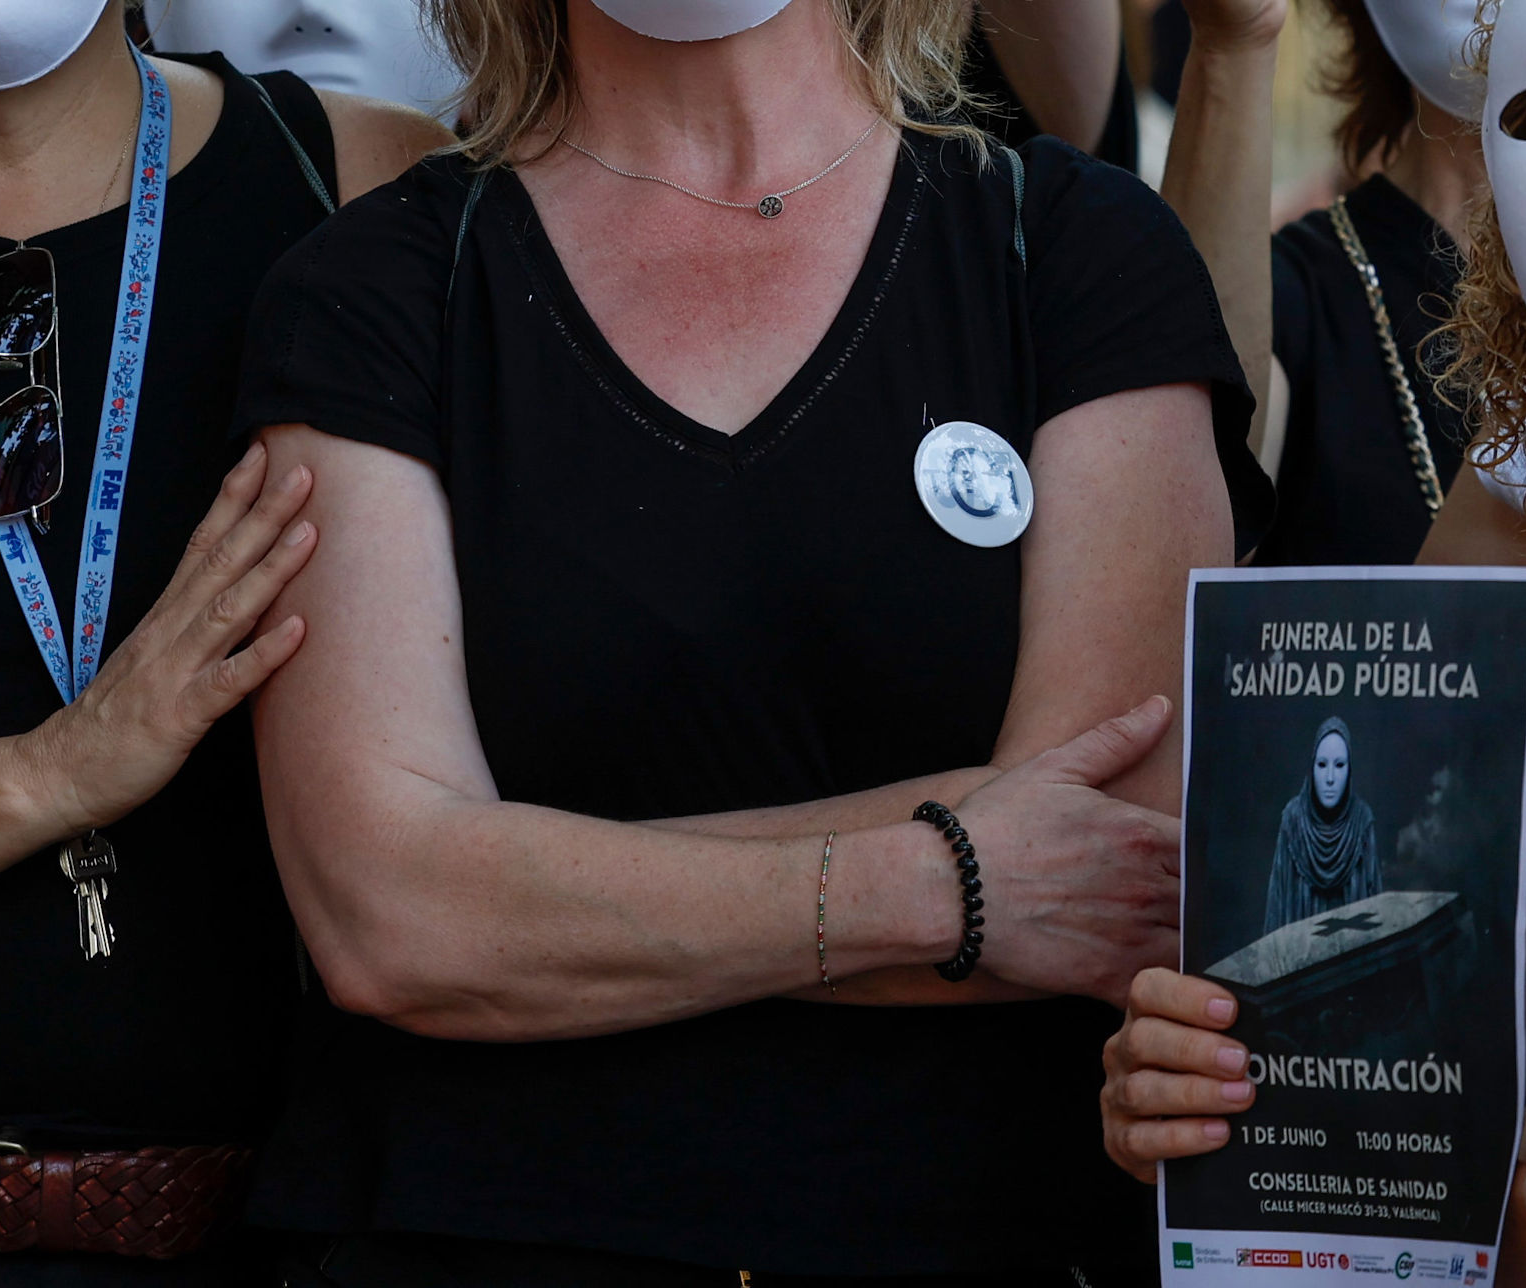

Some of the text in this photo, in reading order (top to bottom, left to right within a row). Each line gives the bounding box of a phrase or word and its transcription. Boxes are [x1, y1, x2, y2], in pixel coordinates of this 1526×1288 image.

[1261, 621, 1433, 652] FUNERAL DE LA
[1230, 655, 1479, 699] SANIDAD PÚBLICA
[1247, 1053, 1463, 1095] ONCENTRACIÓN
[1241, 1126, 1327, 1147] 1 DE JUNIO
[1356, 1131, 1452, 1154] 11:00 HORAS
[1249, 1172, 1448, 1200] CONSELLERIA DE SANIDAD
[1260, 1199, 1294, 1214] (CALLE
[1297, 1200, 1325, 1214] MICER
[1328, 1202, 1362, 1216] MASCÓ
[1254, 1252, 1289, 1264] CCOO
[1307, 1251, 1336, 1269] UGT
